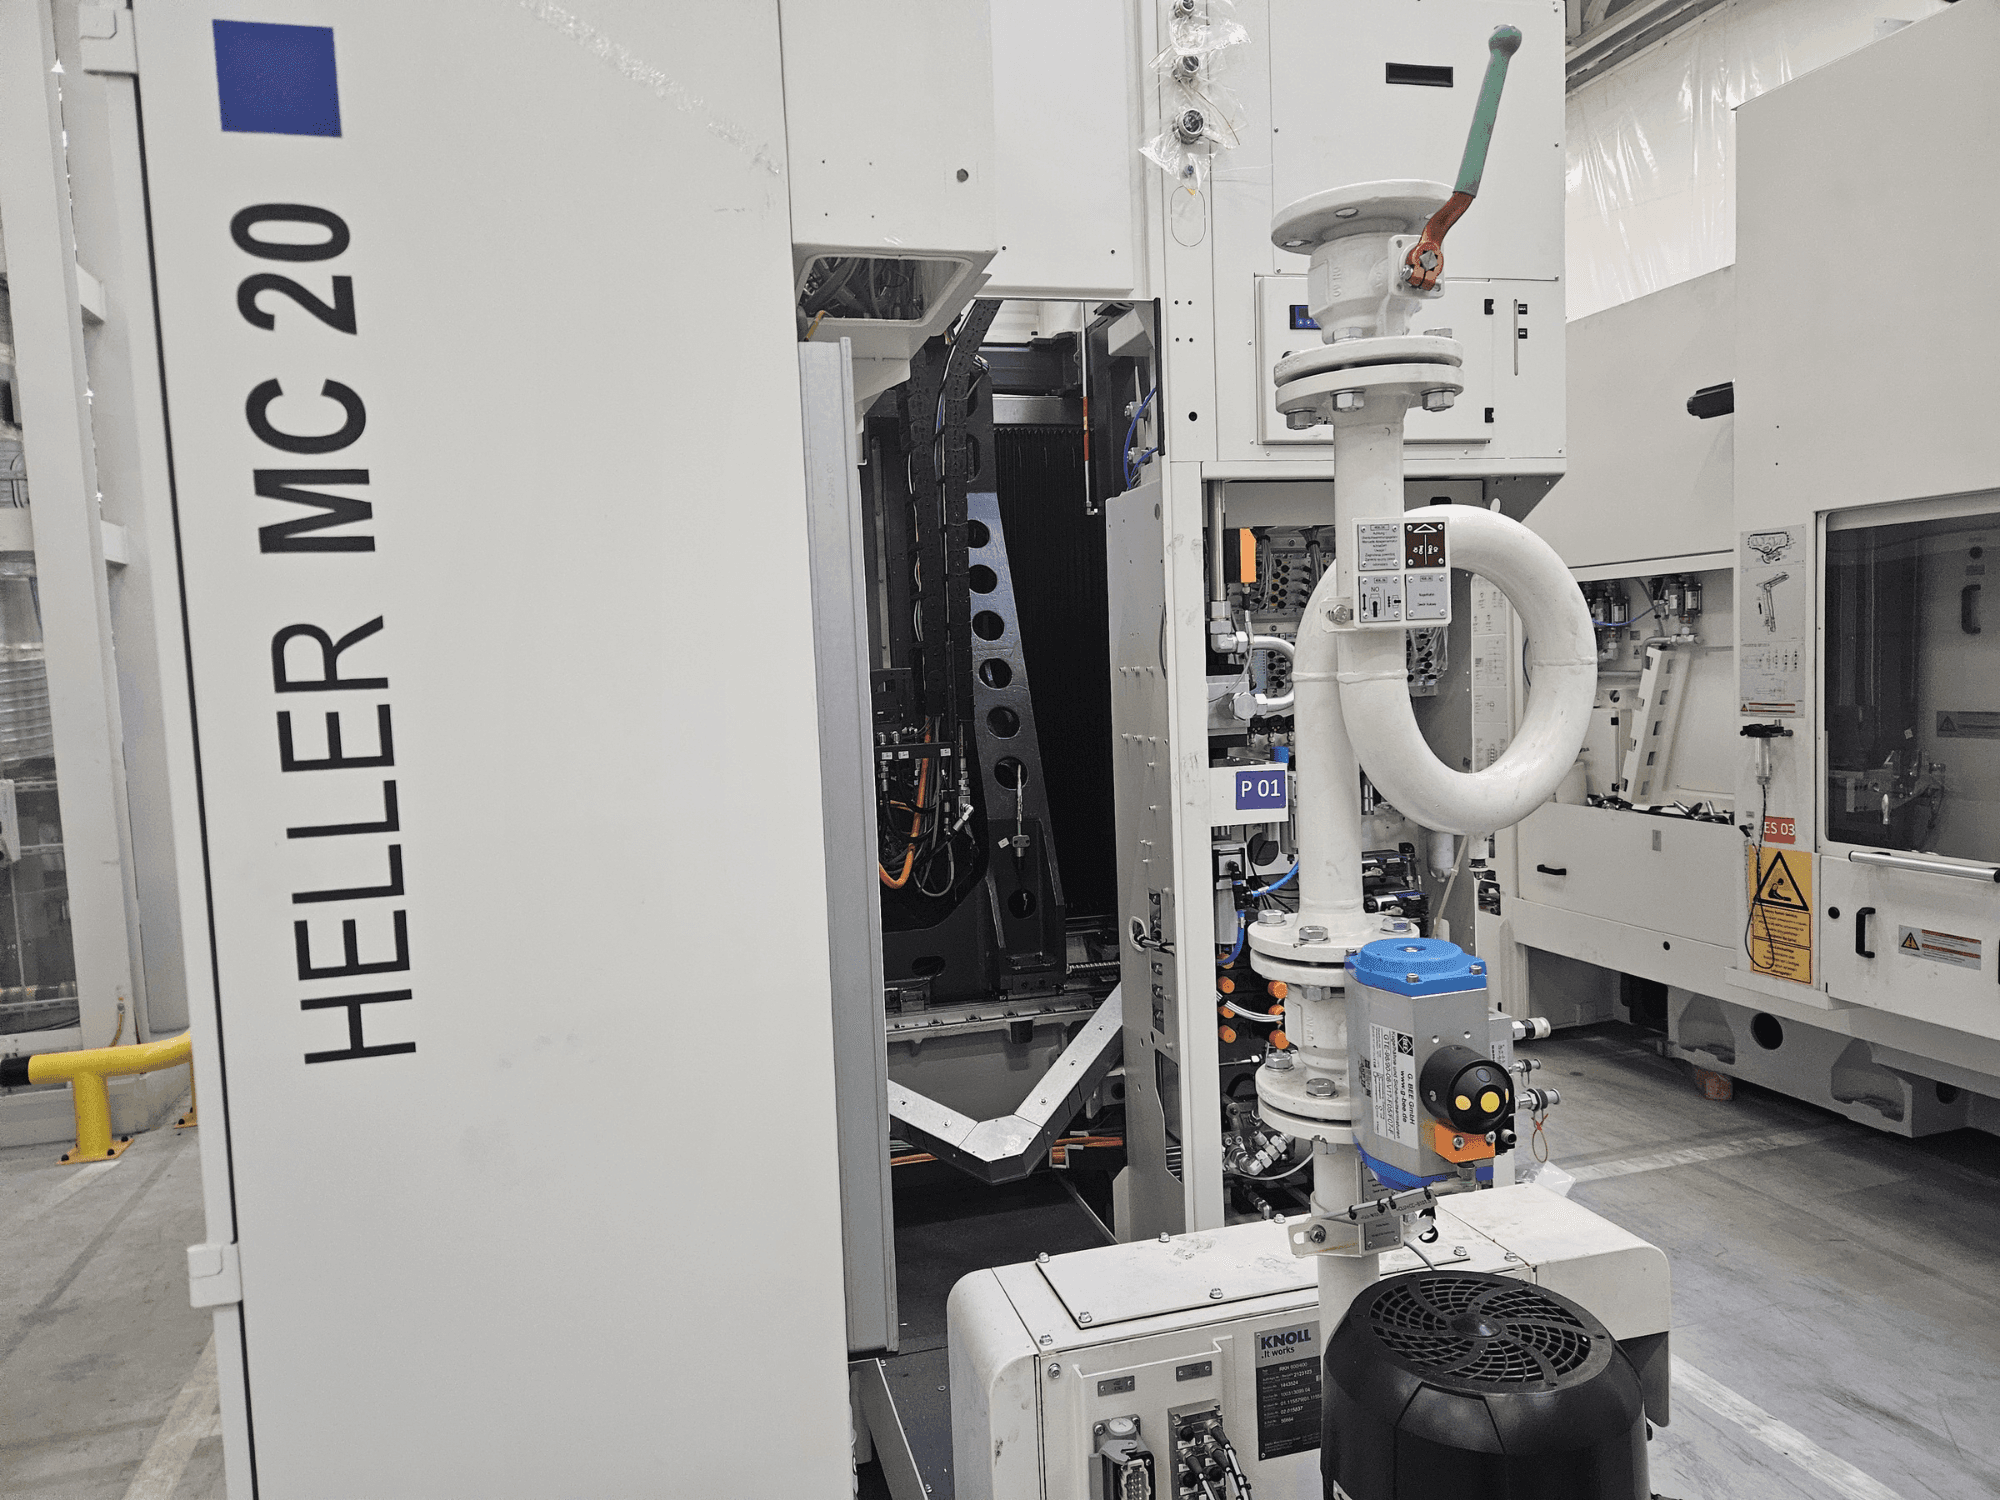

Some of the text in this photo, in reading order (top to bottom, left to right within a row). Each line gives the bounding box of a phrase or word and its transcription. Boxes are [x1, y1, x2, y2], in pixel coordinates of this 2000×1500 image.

[229, 202, 417, 1064] HELLER MC 20
[1241, 778, 1281, 798] P 01
[1780, 823, 1796, 836] 03
[1400, 1070, 1408, 1123] www.g-bee.de
[1261, 1328, 1312, 1350] KNOLL
[1271, 1345, 1295, 1357] works
